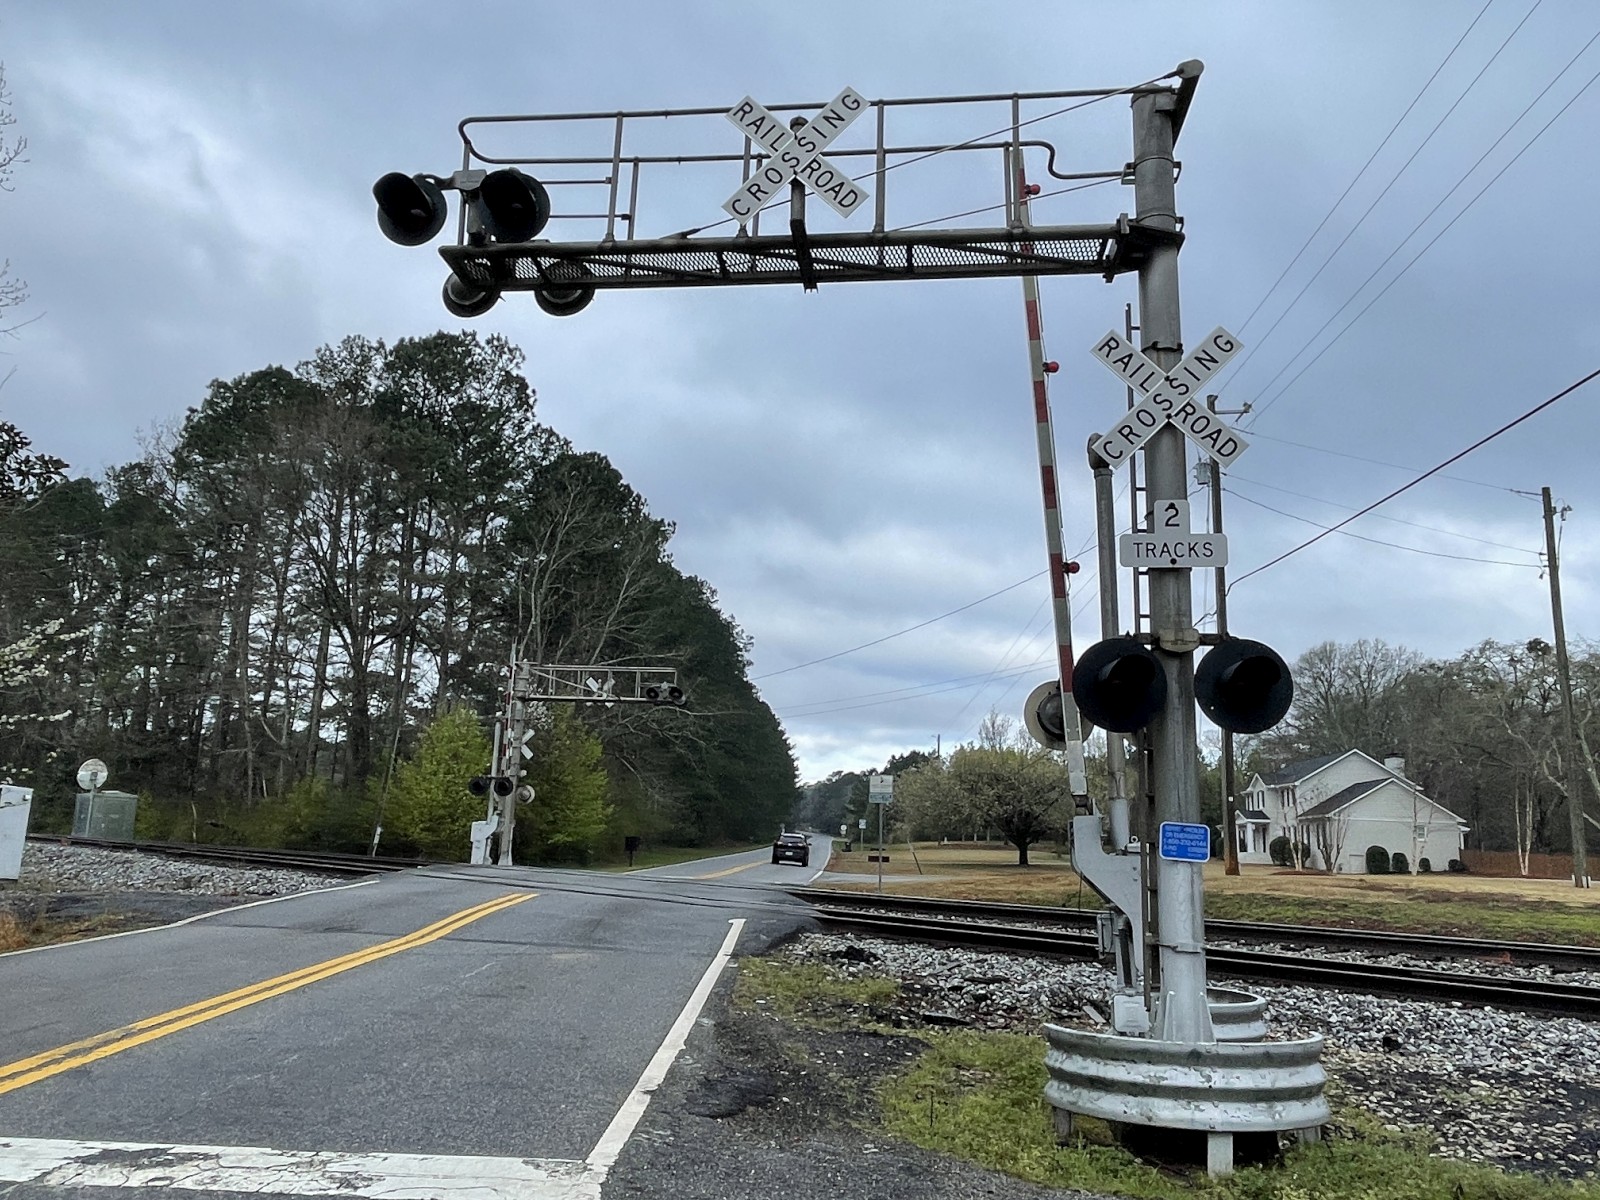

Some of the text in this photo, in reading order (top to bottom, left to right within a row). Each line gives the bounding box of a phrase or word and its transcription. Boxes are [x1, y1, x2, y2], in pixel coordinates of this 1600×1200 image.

[731, 94, 861, 216] CROSSING
[1103, 334, 1235, 461] CROSSING
[1133, 542, 1214, 558] TRACKS
[1164, 506, 1180, 527] 2
